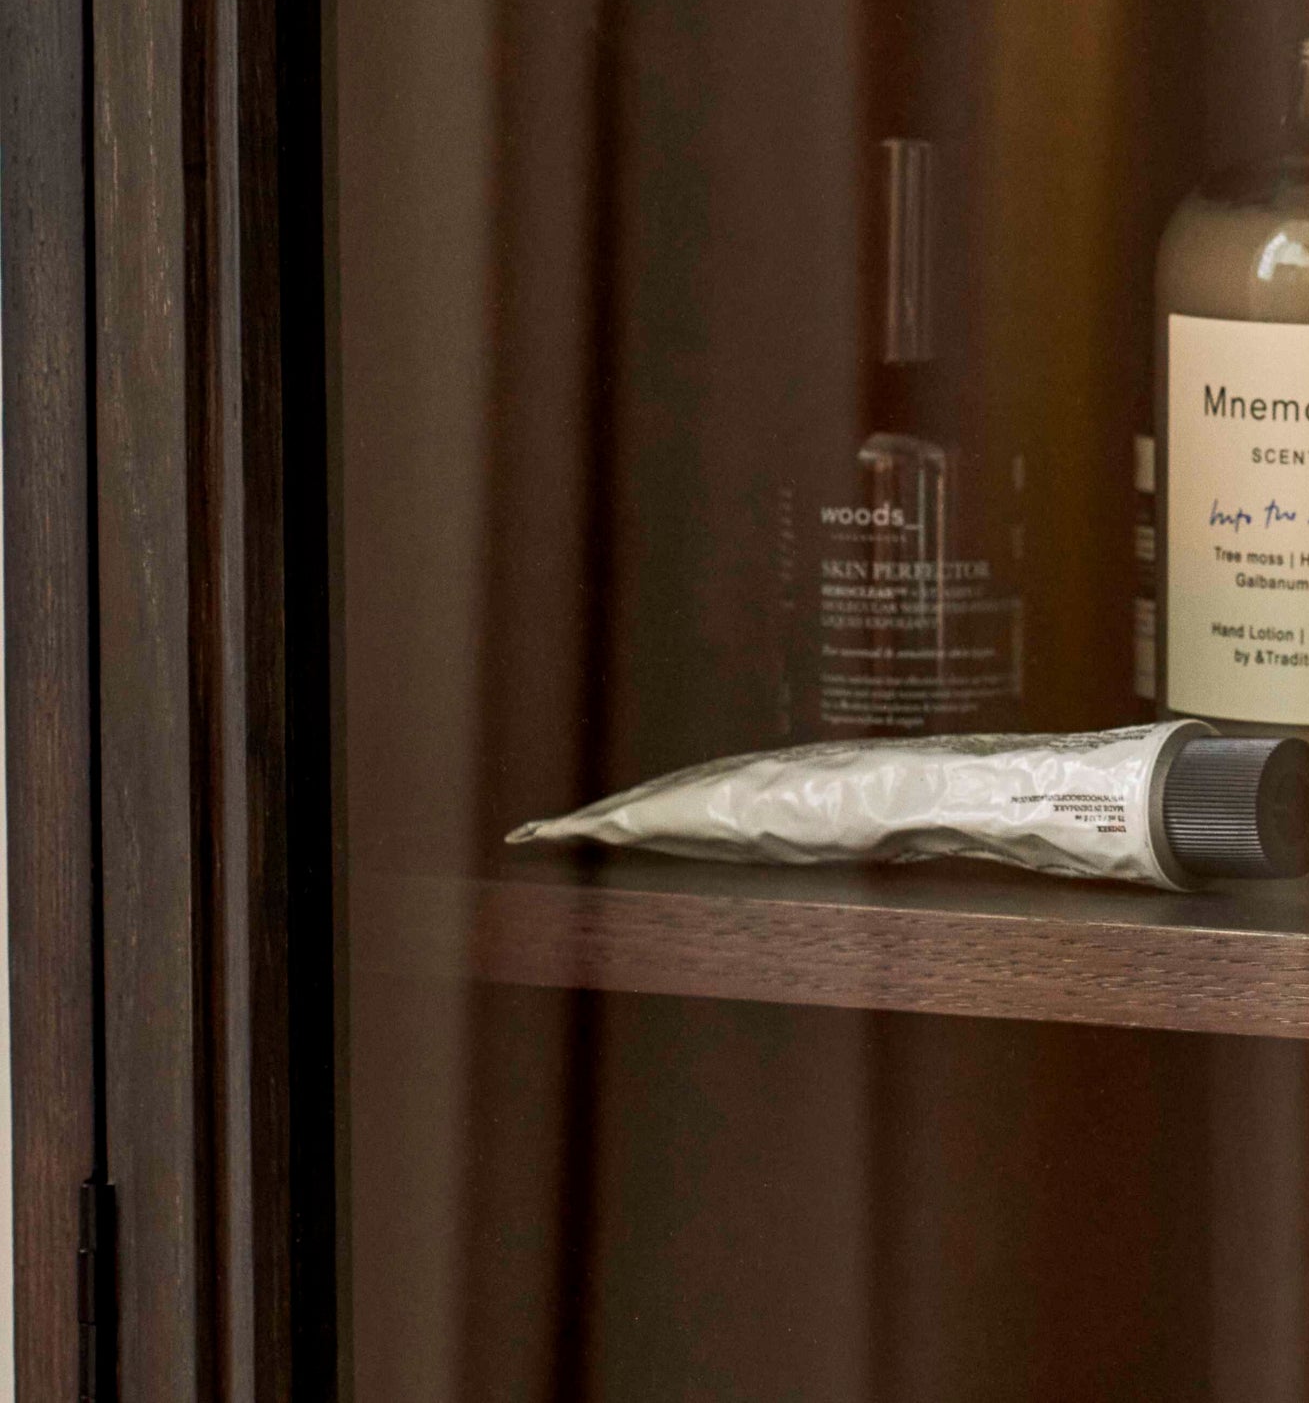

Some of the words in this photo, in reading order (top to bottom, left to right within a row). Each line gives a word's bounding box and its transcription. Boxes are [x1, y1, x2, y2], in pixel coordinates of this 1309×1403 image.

[1214, 545, 1242, 563] Tree
[1246, 551, 1284, 567] moss
[1235, 572, 1309, 592] Galbanum
[1211, 621, 1245, 639] Hand
[1249, 624, 1294, 641] Lotion
[1234, 648, 1250, 666] by
